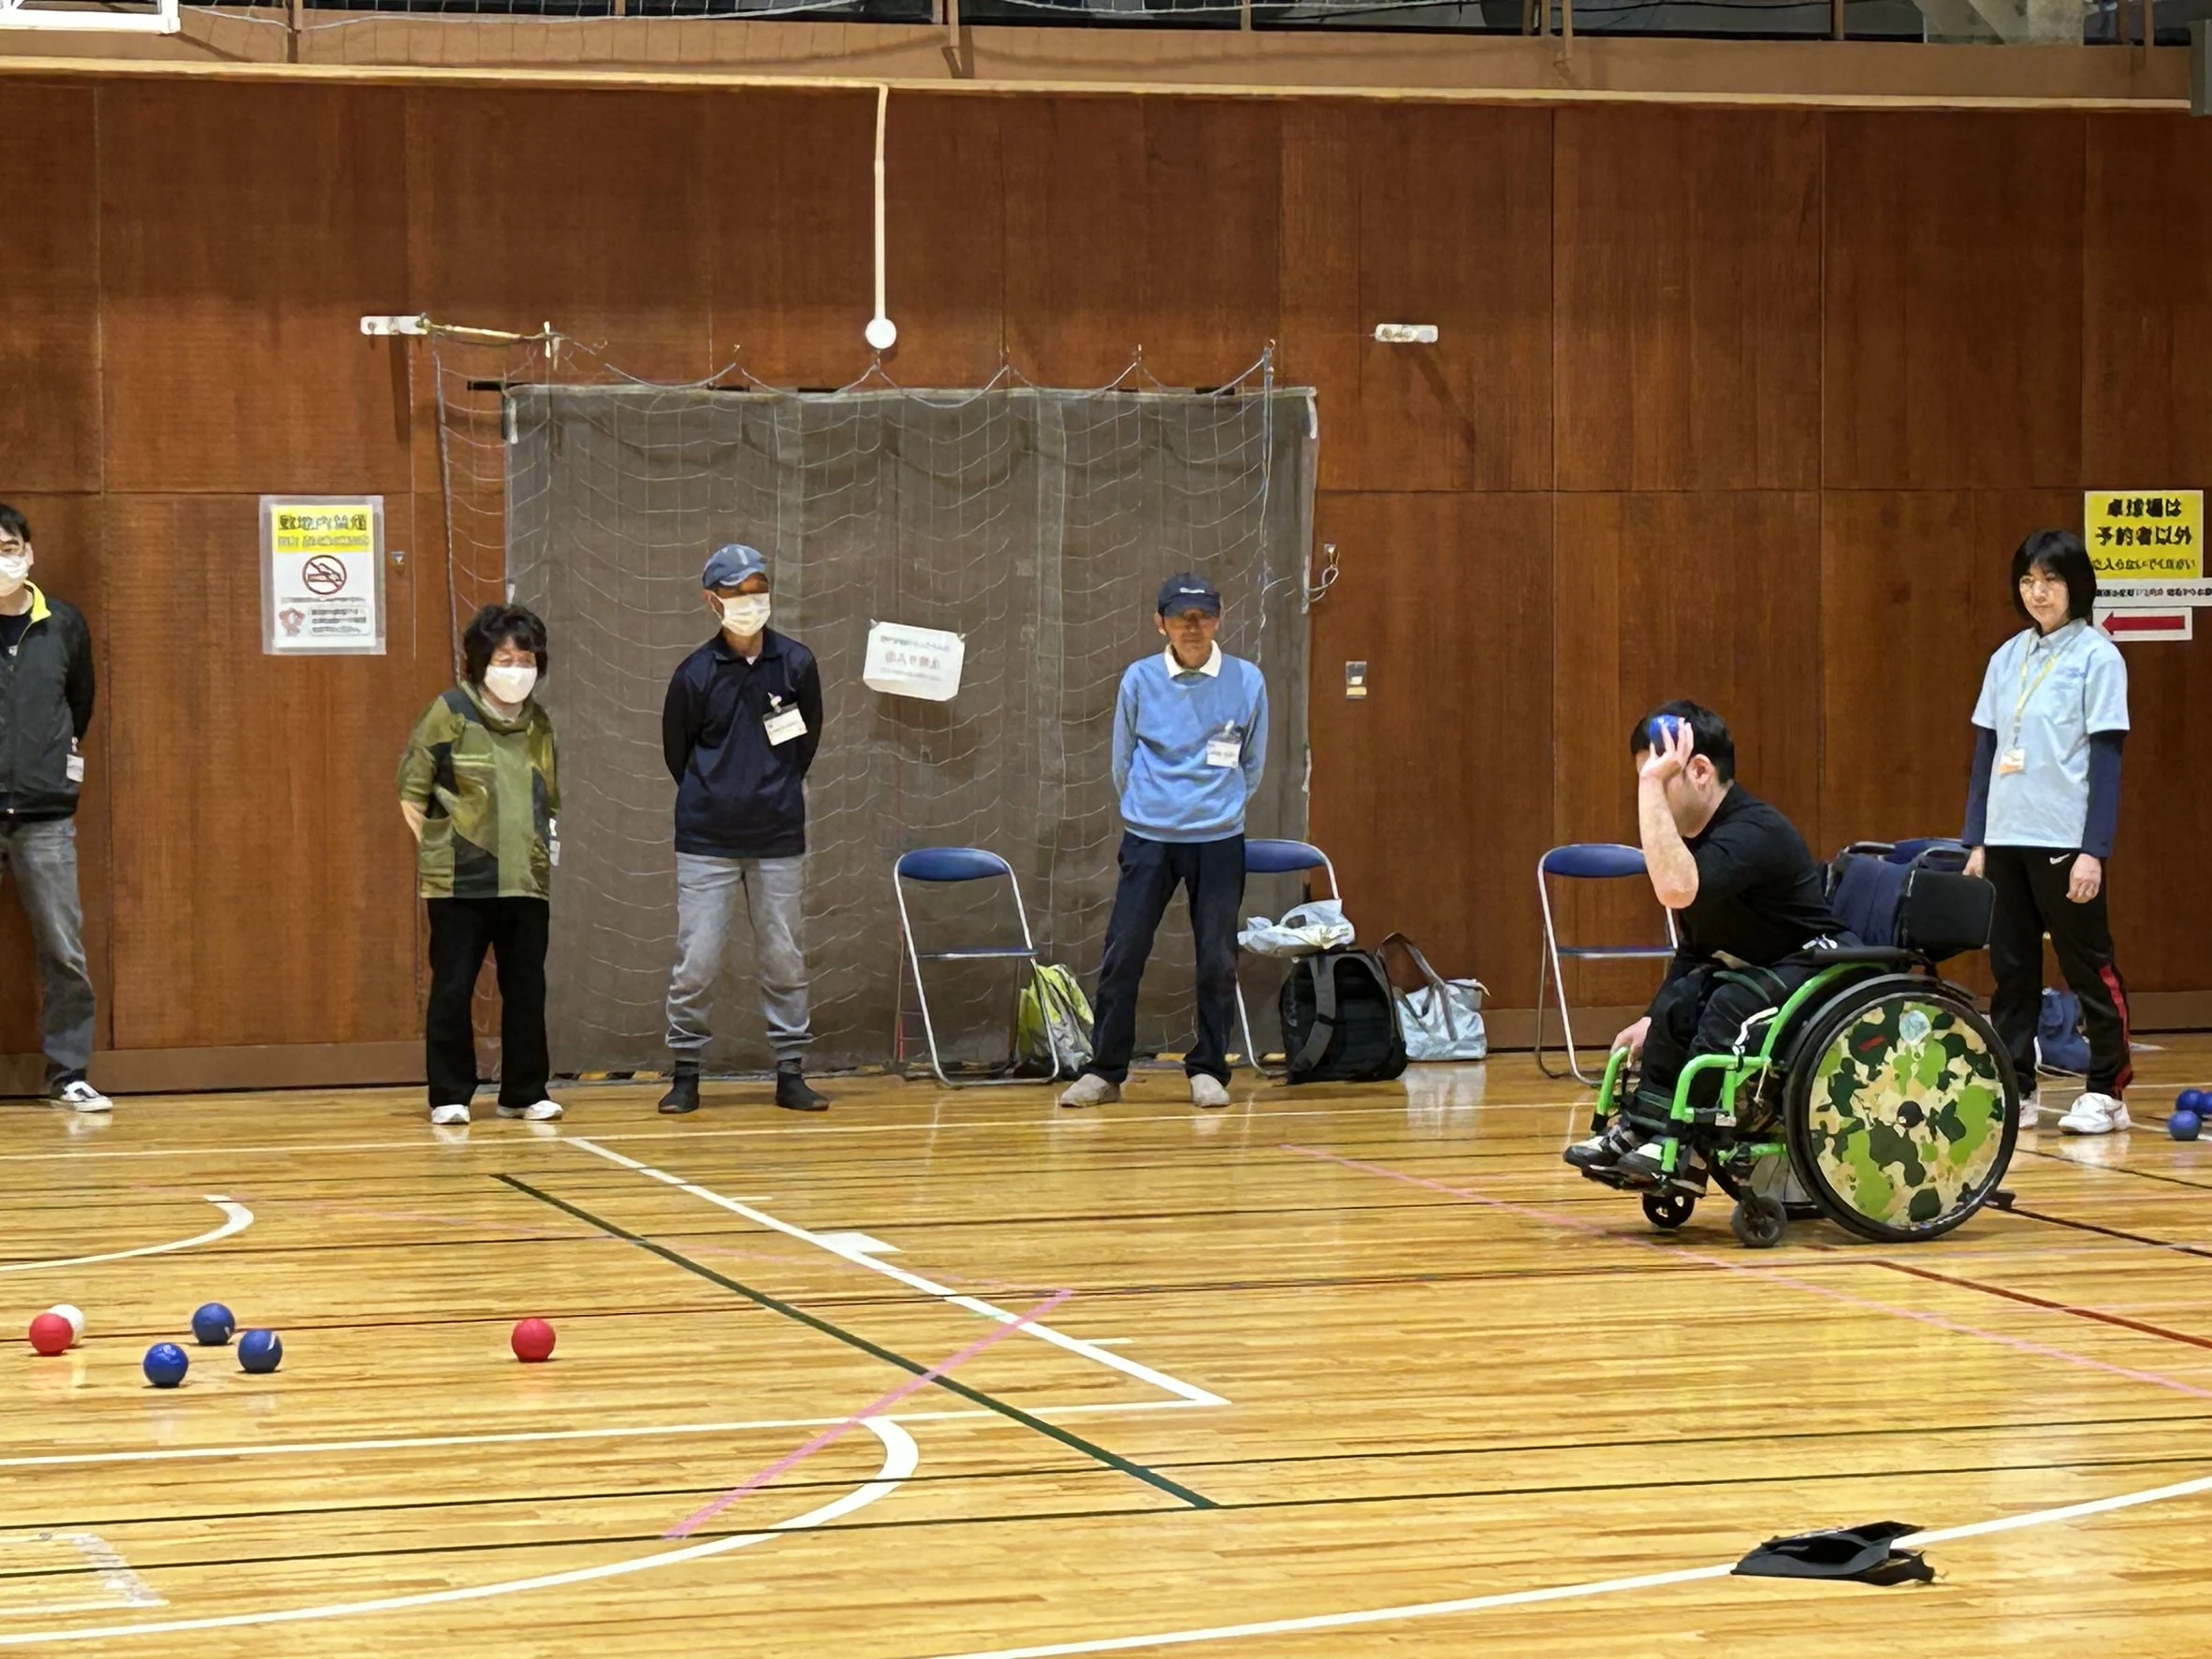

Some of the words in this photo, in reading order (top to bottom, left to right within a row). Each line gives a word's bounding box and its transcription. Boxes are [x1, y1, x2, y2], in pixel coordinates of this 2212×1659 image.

[2095, 526, 2192, 546] 予約者以外
